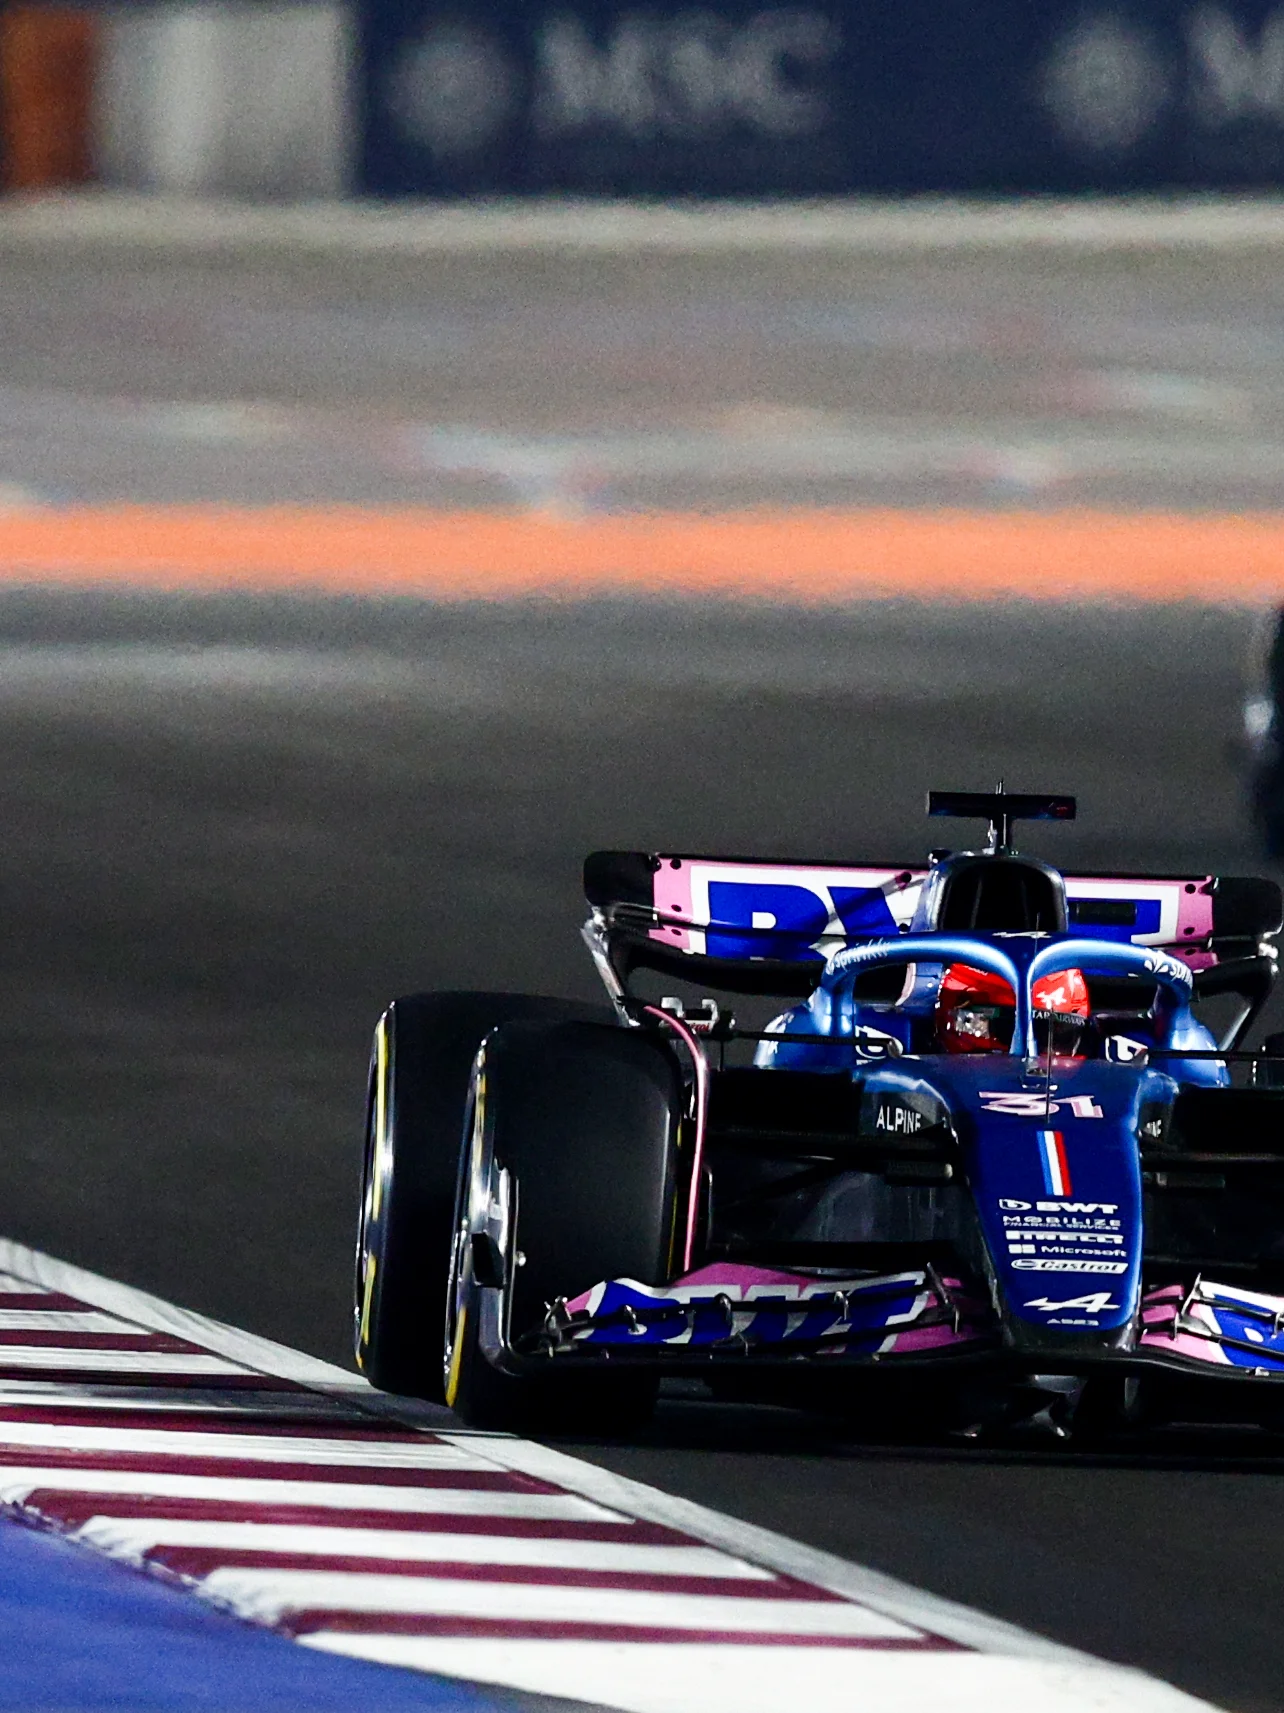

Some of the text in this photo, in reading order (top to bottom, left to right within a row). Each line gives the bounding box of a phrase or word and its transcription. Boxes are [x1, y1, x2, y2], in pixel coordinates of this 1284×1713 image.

[979, 1091, 1104, 1118] 31
[876, 1105, 922, 1134] ALPINE
[1036, 1201, 1119, 1214] BWT
[1003, 1215, 1121, 1227] MOBILIZE
[1006, 1230, 1124, 1244] PIRELLI
[1041, 1246, 1127, 1257] Microsoft
[1040, 1260, 1120, 1272] Castrol
